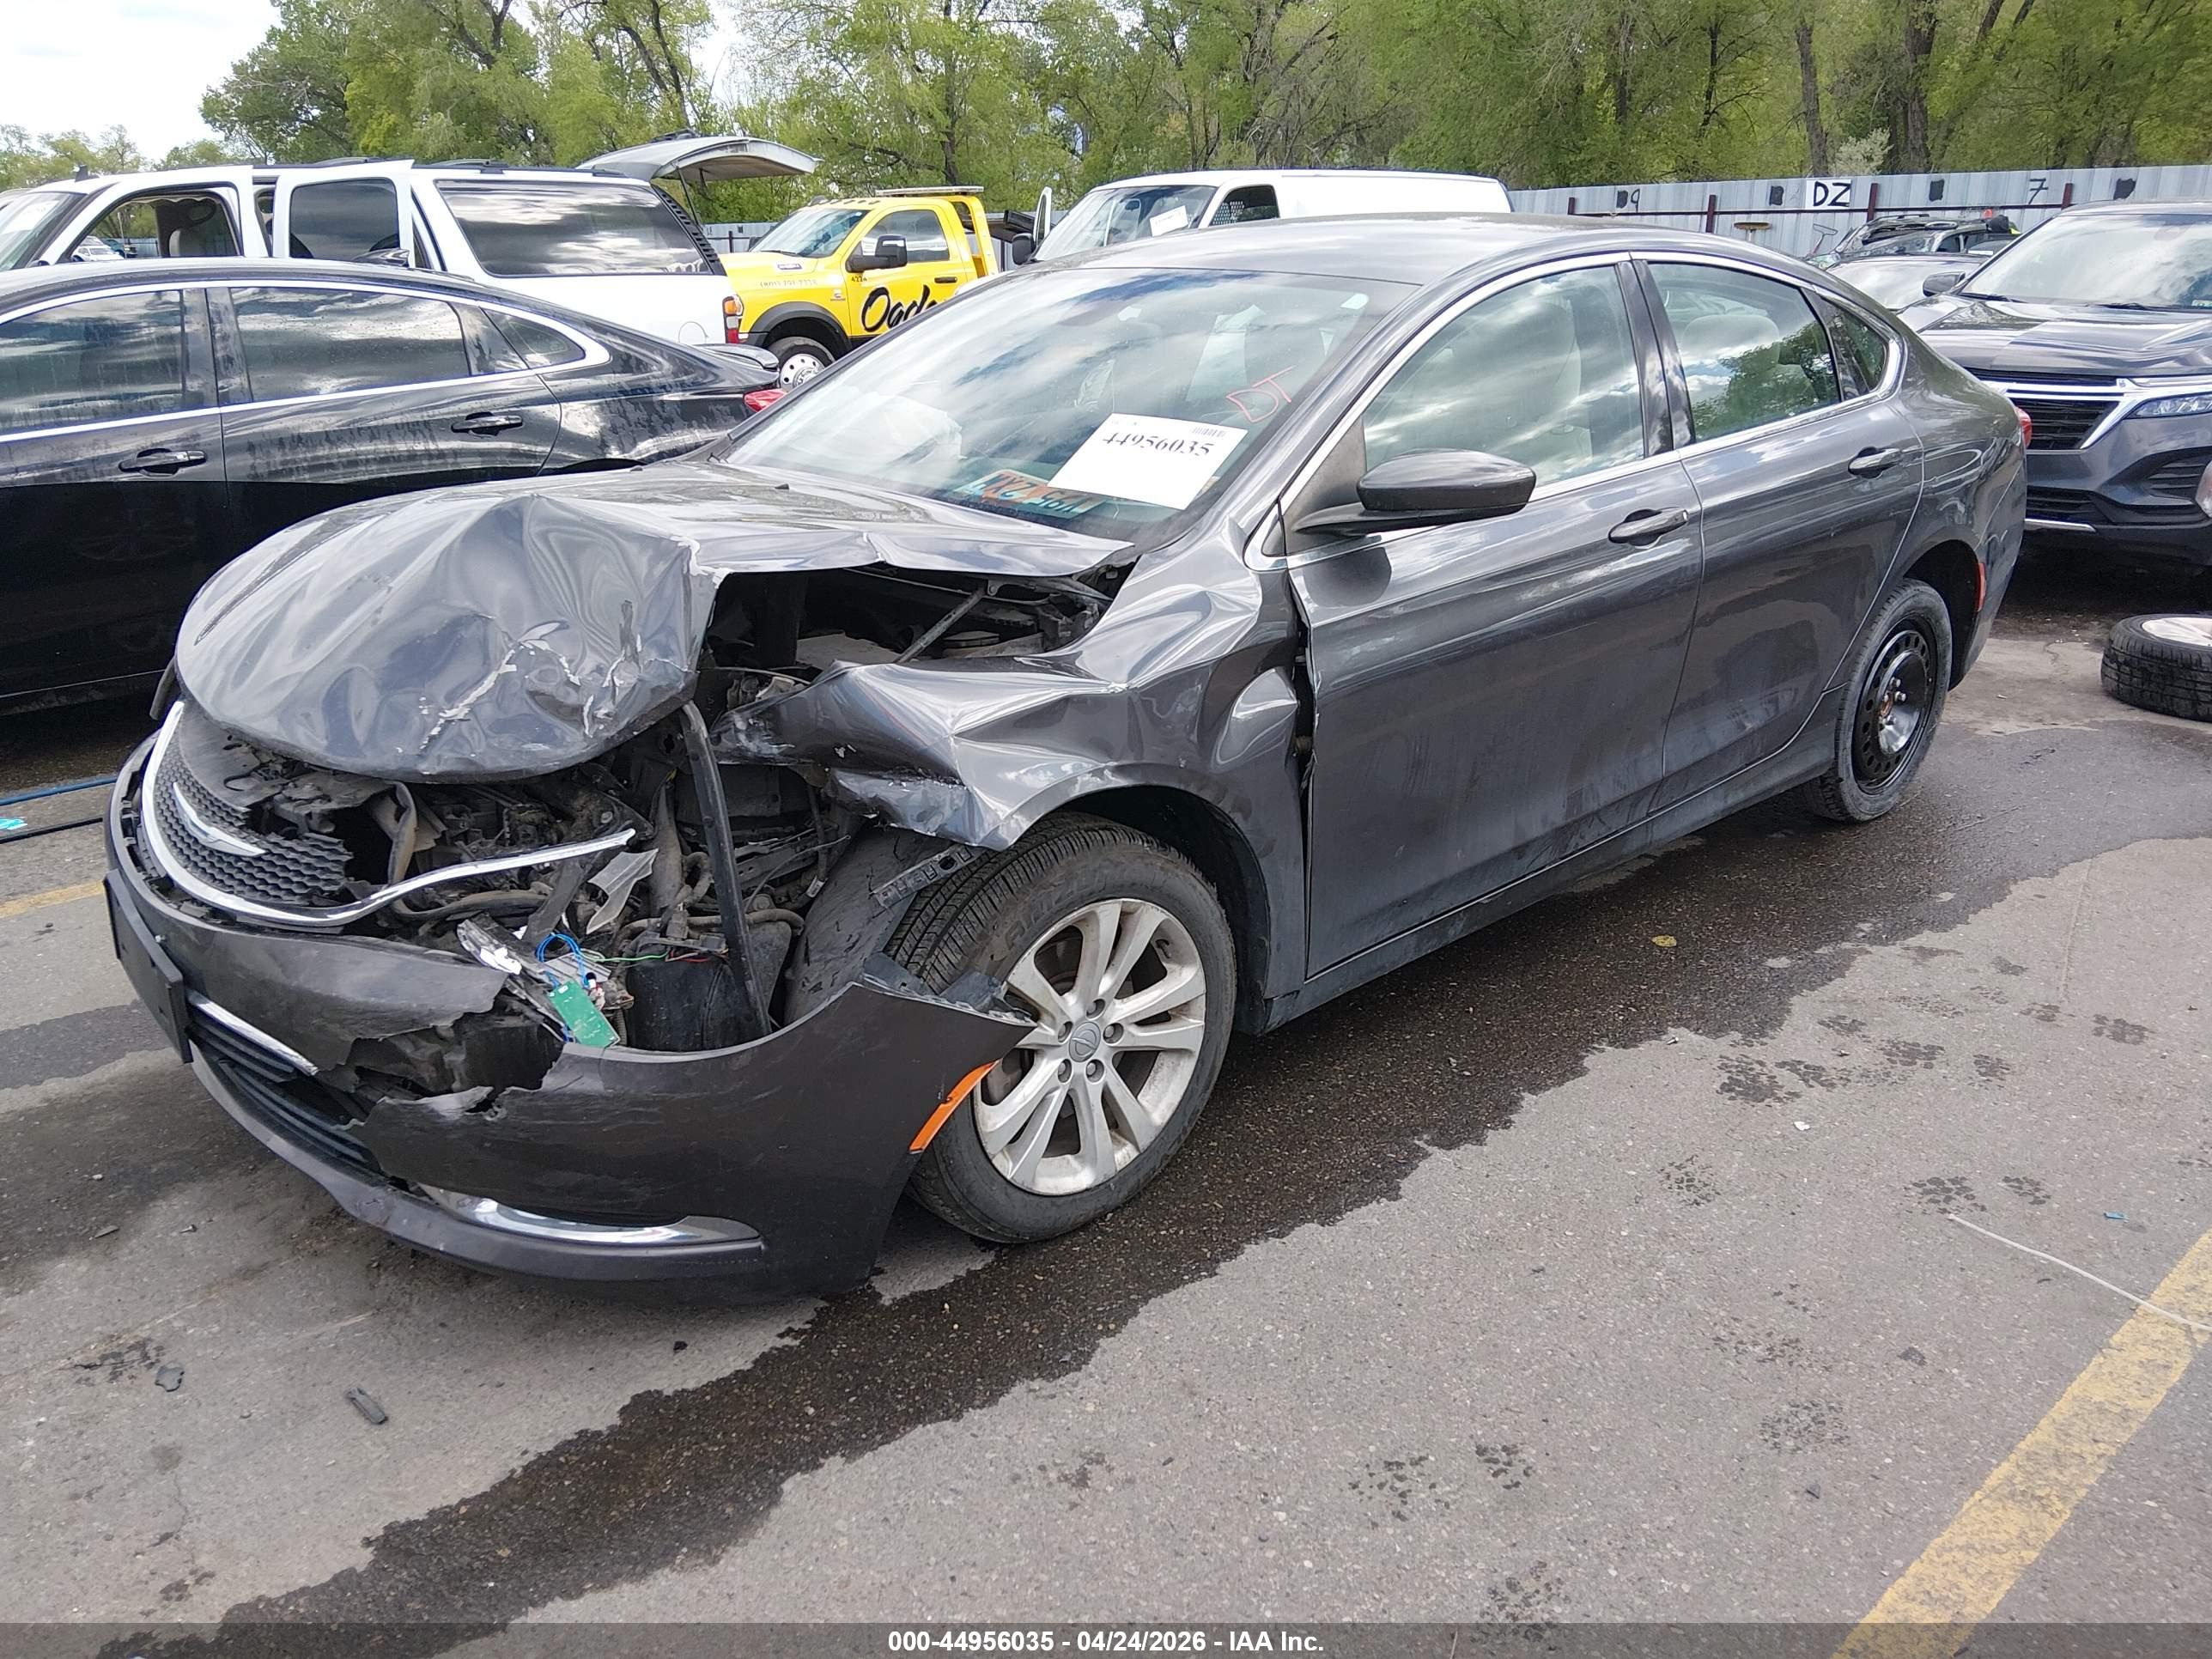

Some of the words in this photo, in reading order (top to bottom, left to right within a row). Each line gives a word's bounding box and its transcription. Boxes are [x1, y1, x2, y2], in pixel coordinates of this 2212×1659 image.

[2029, 178, 2049, 204] 7
[861, 284, 938, 332] Ogd
[1103, 432, 1216, 456] 44956035
